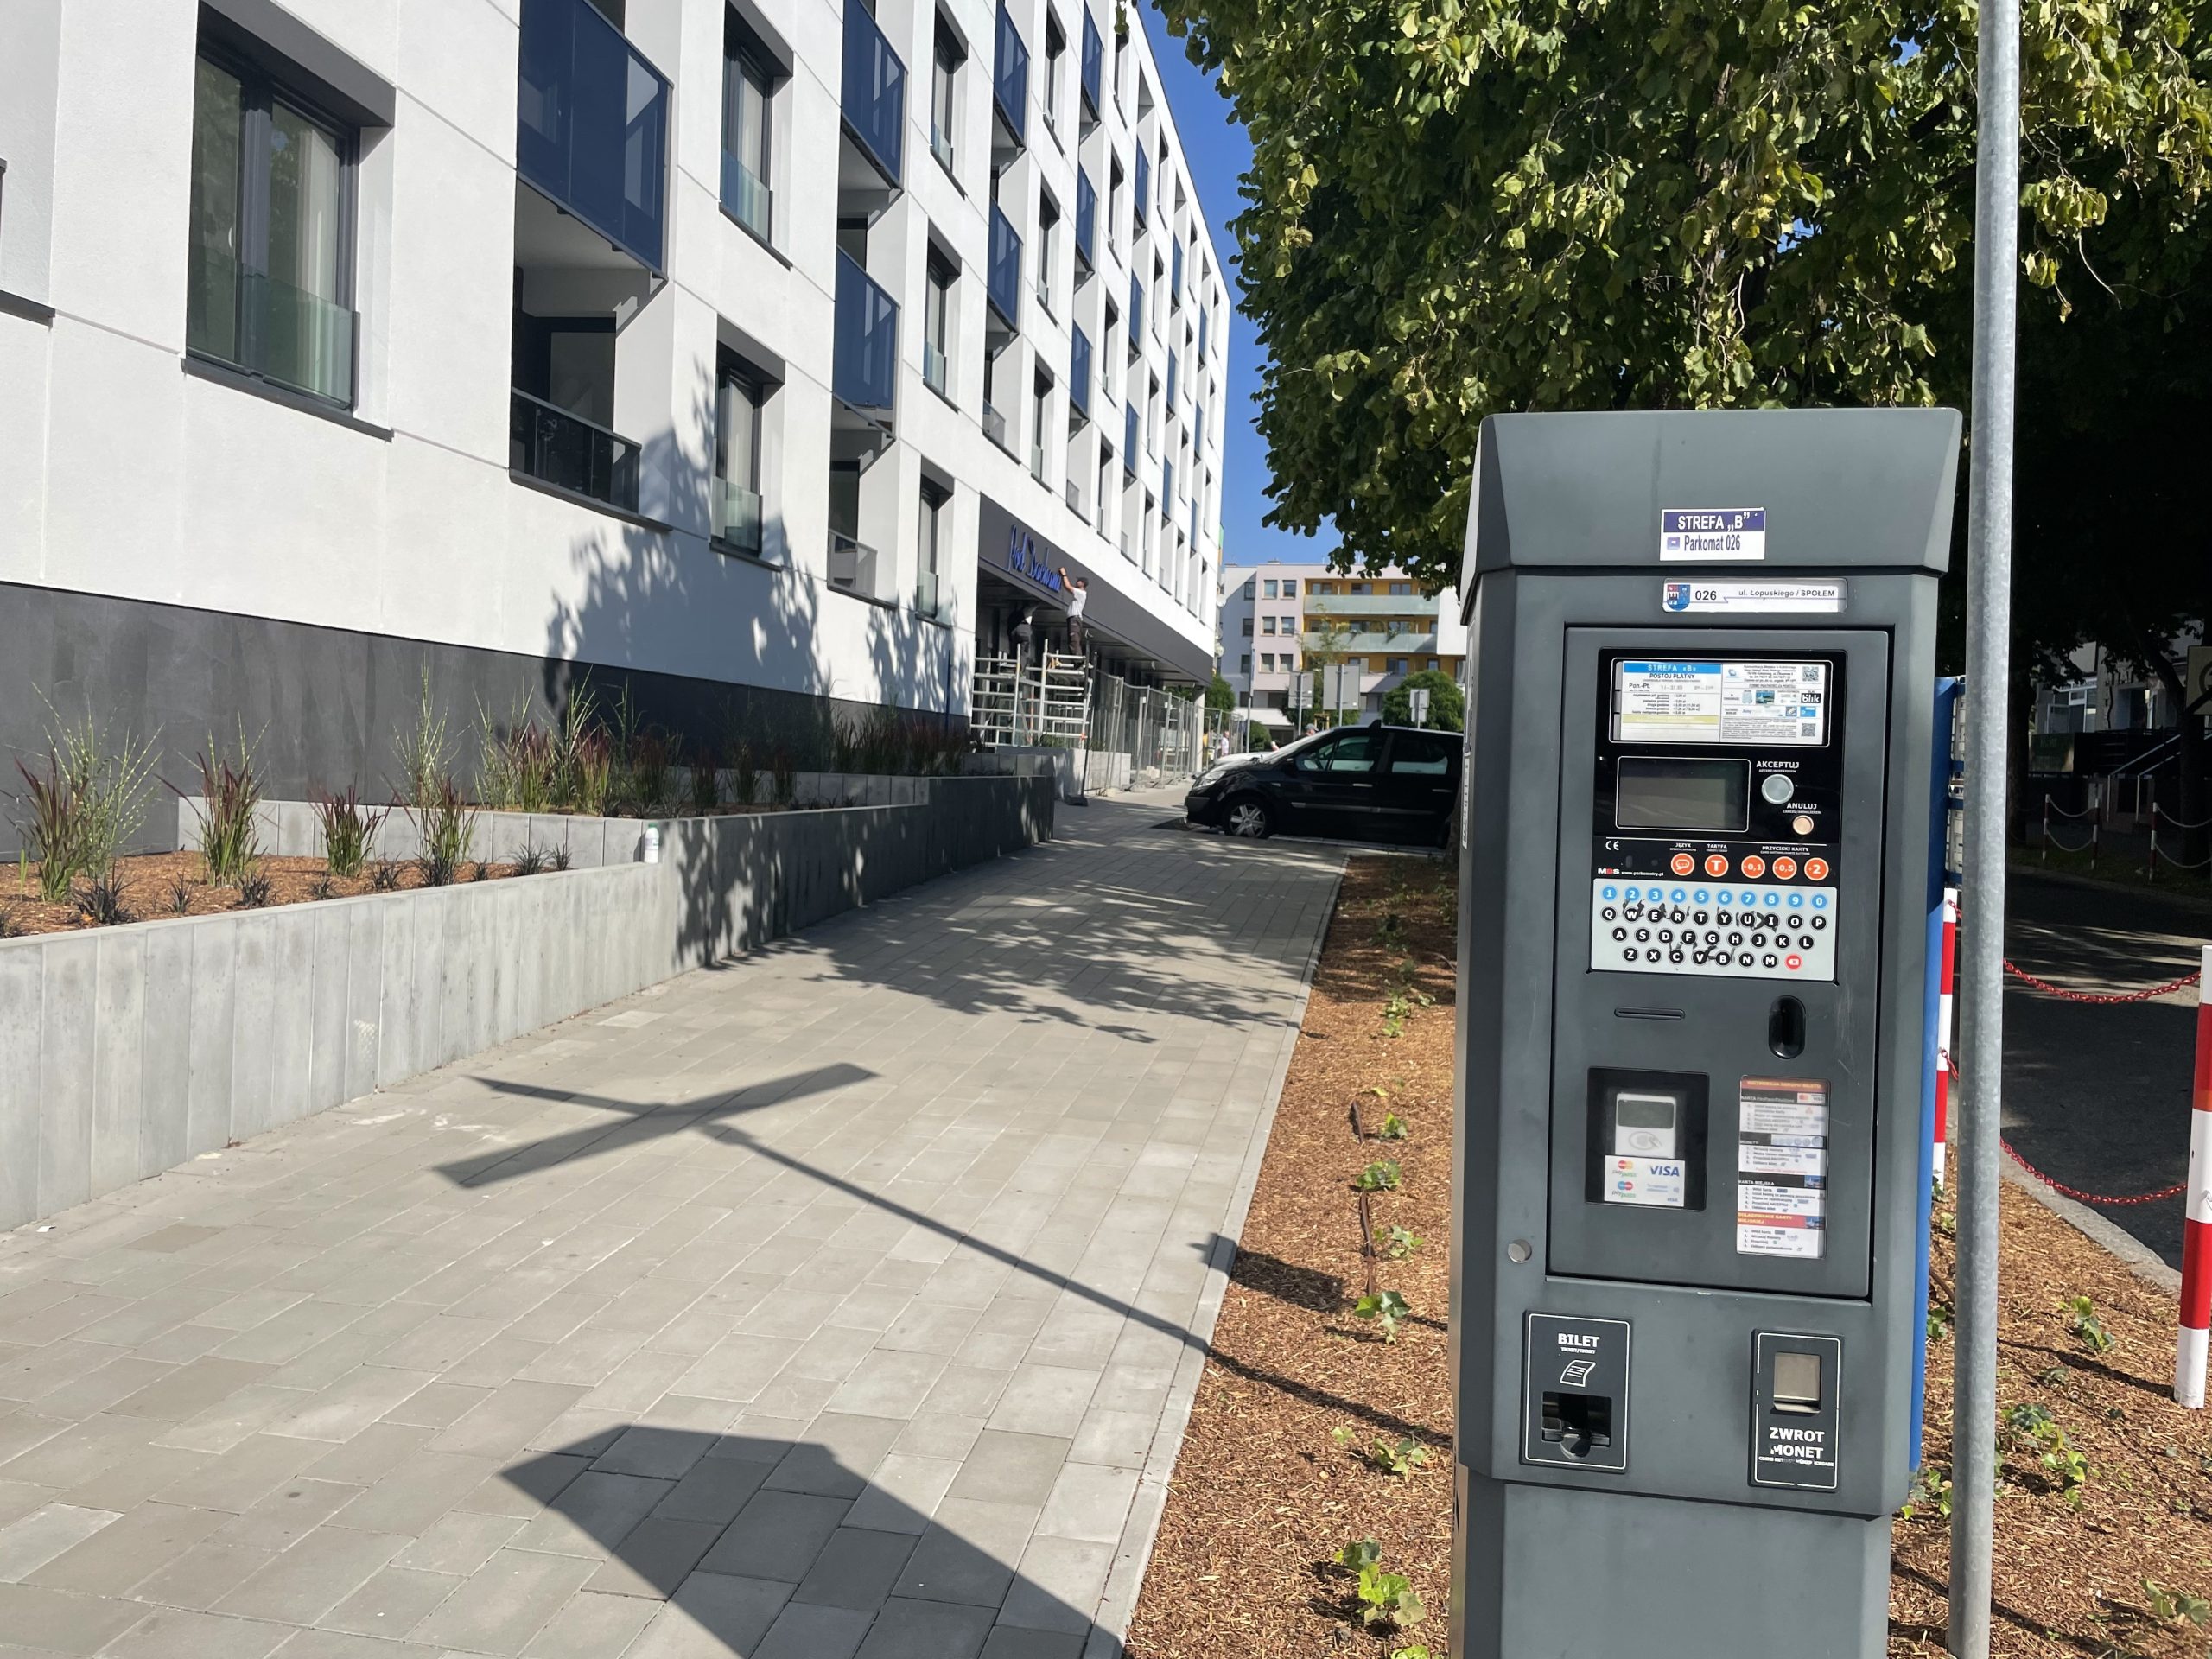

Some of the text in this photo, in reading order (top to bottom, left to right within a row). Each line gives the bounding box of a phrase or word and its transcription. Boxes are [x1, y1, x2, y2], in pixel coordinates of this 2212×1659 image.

[1678, 515, 1725, 530] STREFA
[1683, 534, 1741, 551] Parkomat 026
[1694, 590, 1717, 601] 026
[1750, 589, 1795, 598] Łopuskiego
[1802, 694, 1821, 703] blik
[1756, 760, 1800, 769] AKCEPTUJ
[1711, 860, 1722, 871] T
[1650, 1166, 1680, 1177] VISA
[1558, 1333, 1600, 1347] BILET
[1770, 1427, 1825, 1443] ZWROT
[1770, 1445, 1824, 1459] MONET
